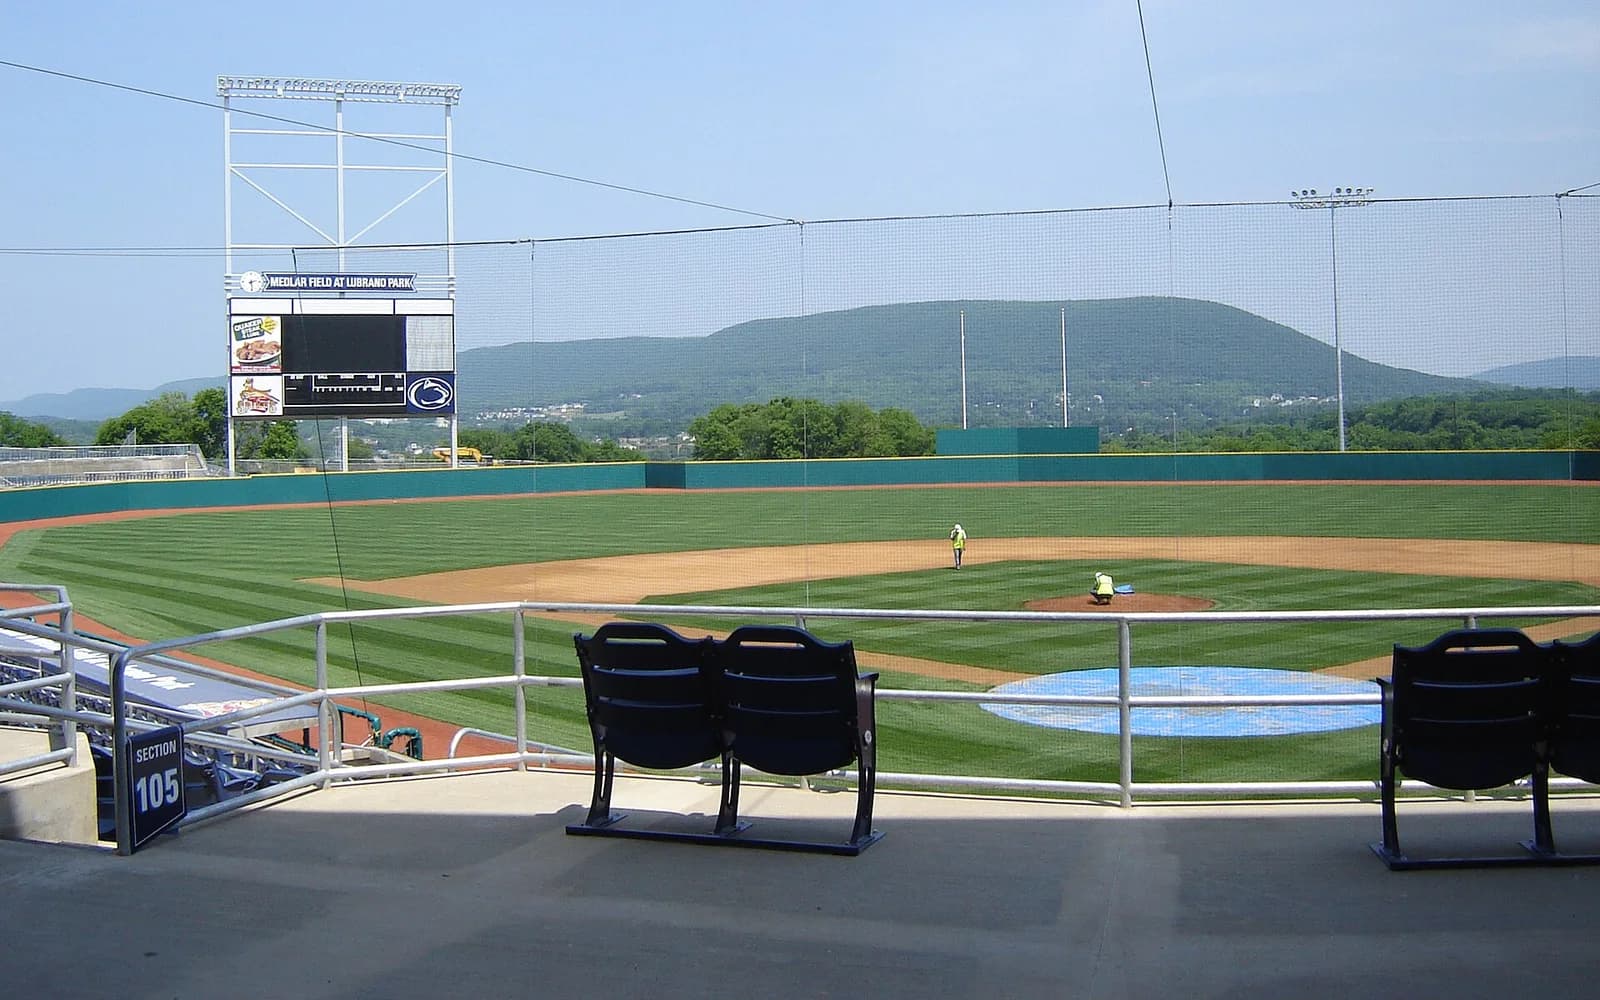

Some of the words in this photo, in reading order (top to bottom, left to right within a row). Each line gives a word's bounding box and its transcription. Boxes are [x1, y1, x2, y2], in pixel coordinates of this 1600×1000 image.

[270, 277, 308, 288] MEDLAR
[309, 277, 333, 288] FIELD
[334, 277, 346, 288] AT
[347, 277, 388, 288] LUBRANO
[389, 277, 413, 289] PARK
[136, 739, 177, 764] SECTION
[136, 767, 180, 813] 105
